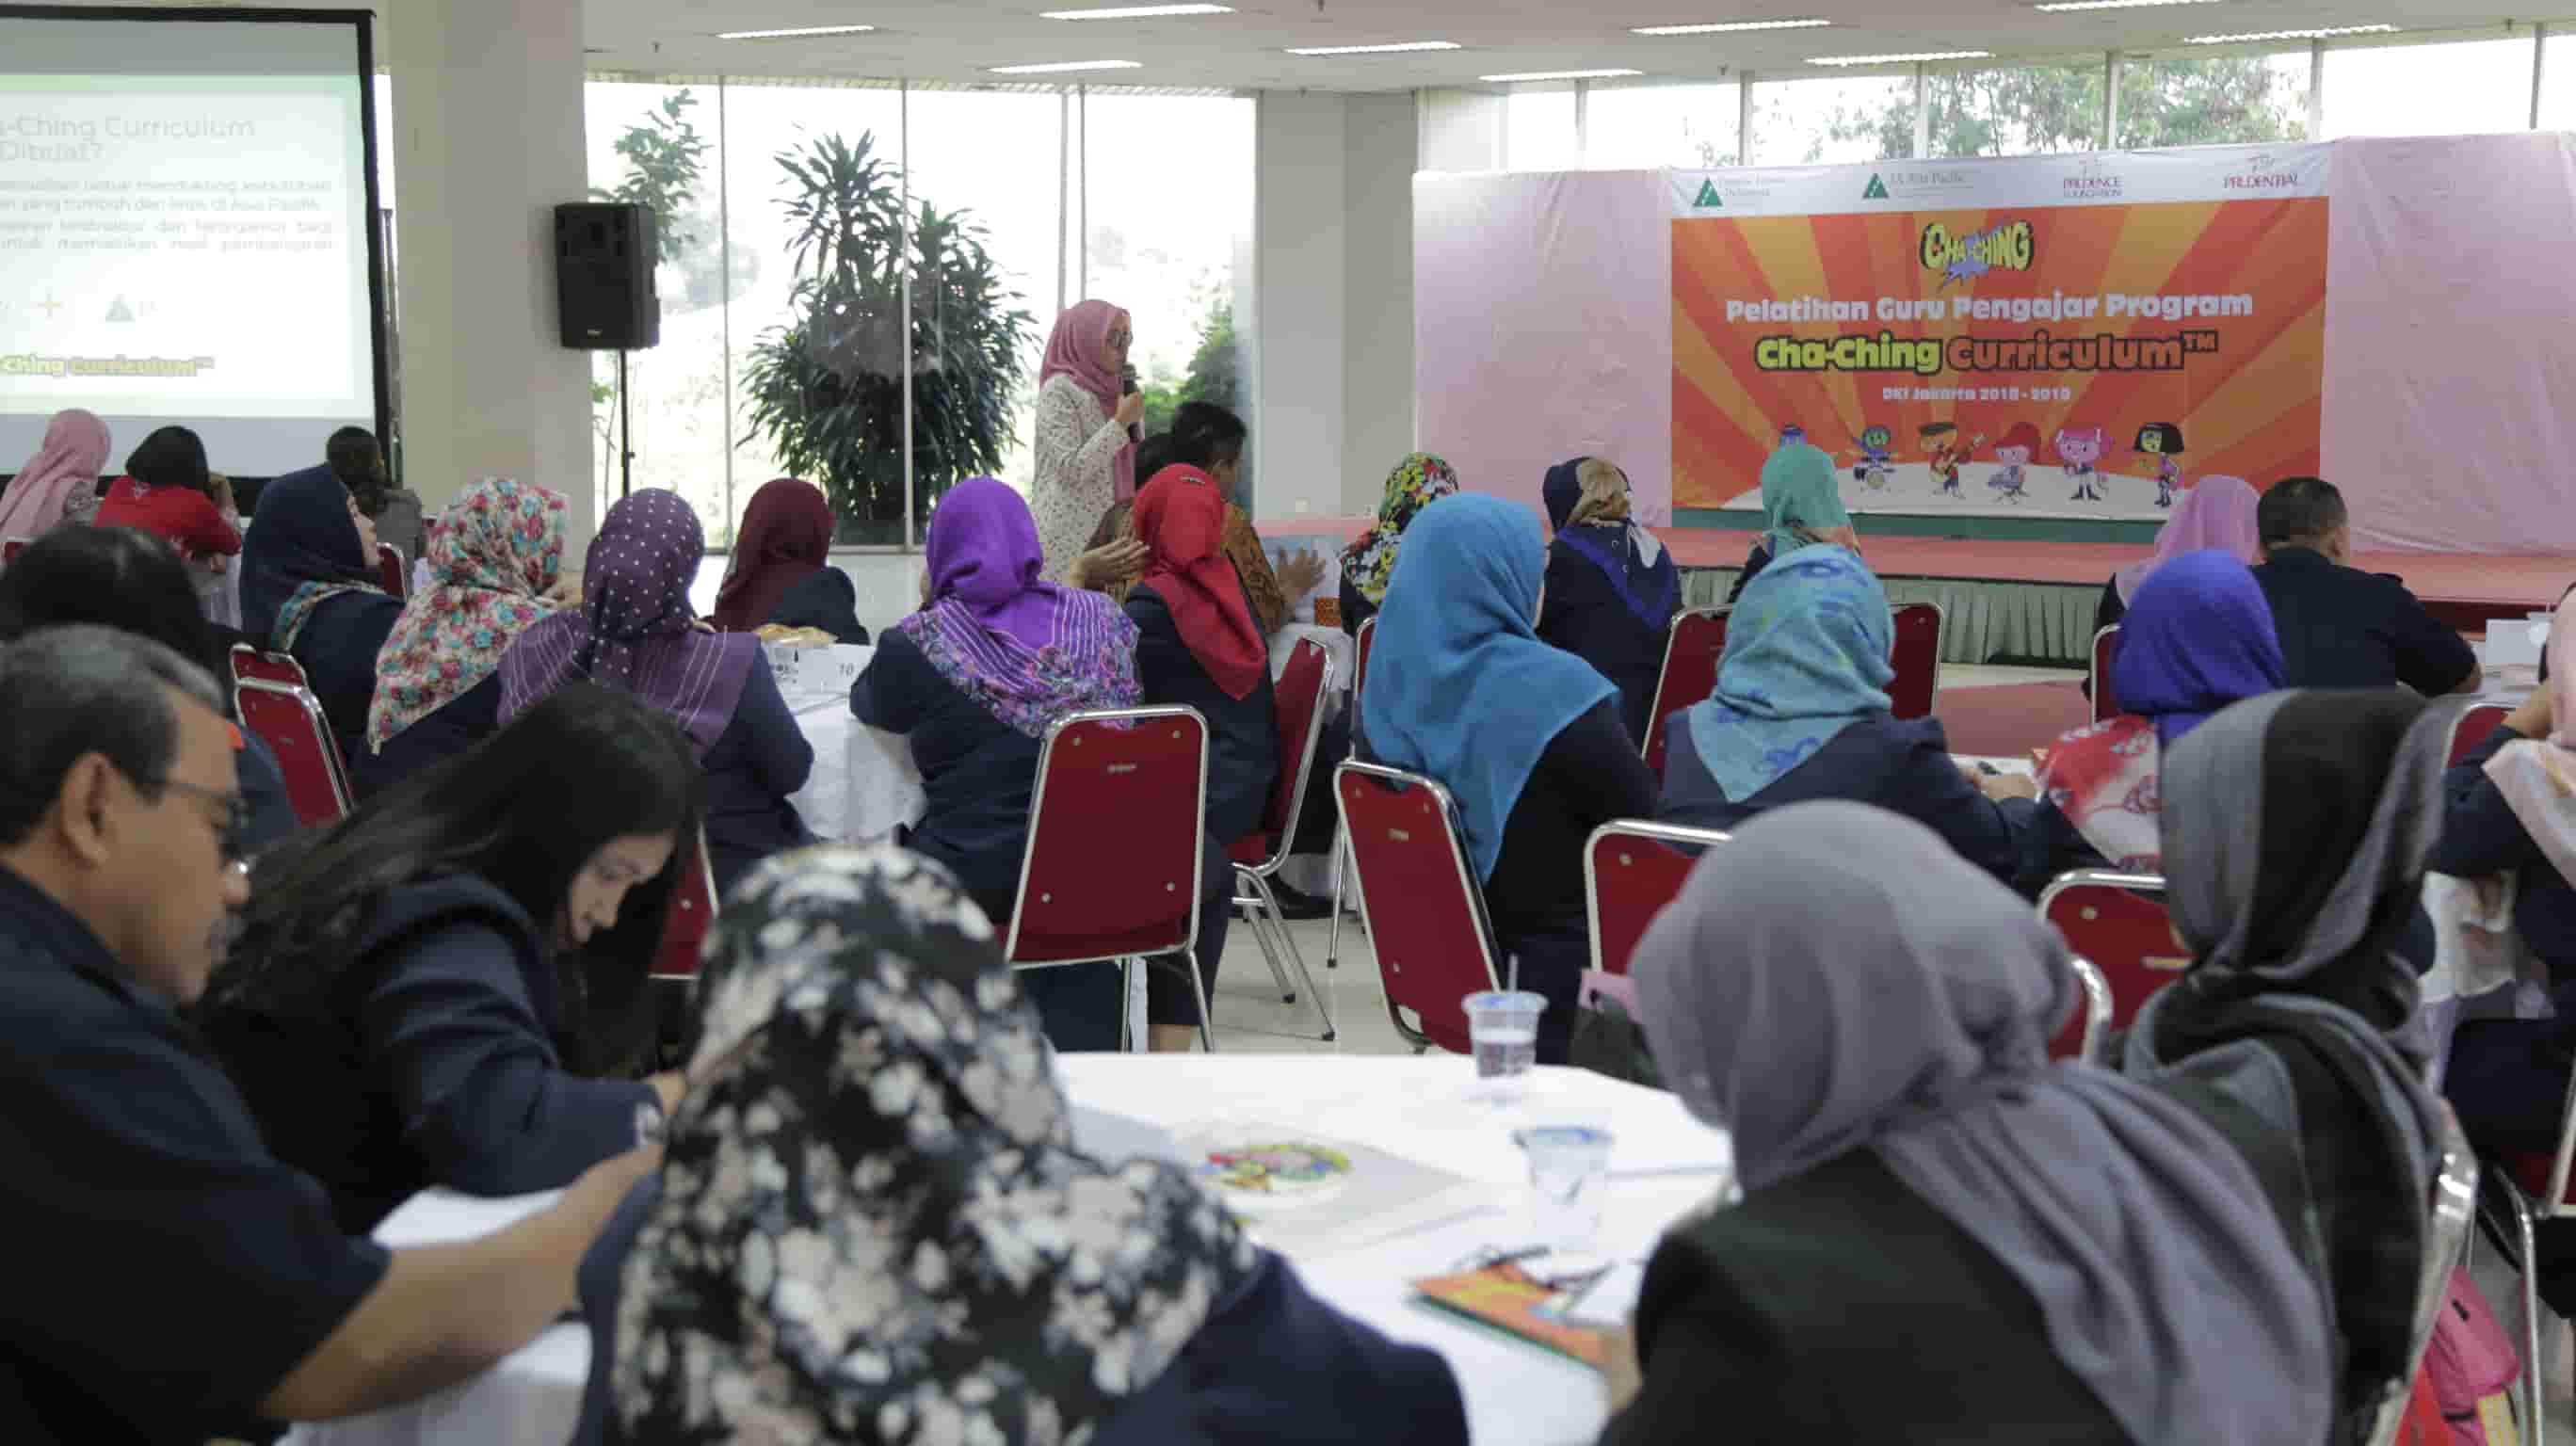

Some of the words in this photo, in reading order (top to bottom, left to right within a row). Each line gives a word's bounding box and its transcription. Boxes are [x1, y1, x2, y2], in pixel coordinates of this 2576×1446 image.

[105, 112, 256, 138] Curriculum
[2223, 172, 2298, 189] PRUDENTIAL
[1726, 296, 1870, 322] Pelatihan
[1876, 297, 1945, 321] Guru
[1953, 290, 2099, 323] Pengajar
[2105, 293, 2253, 321] Program
[1754, 329, 1943, 375] Cha-Ching
